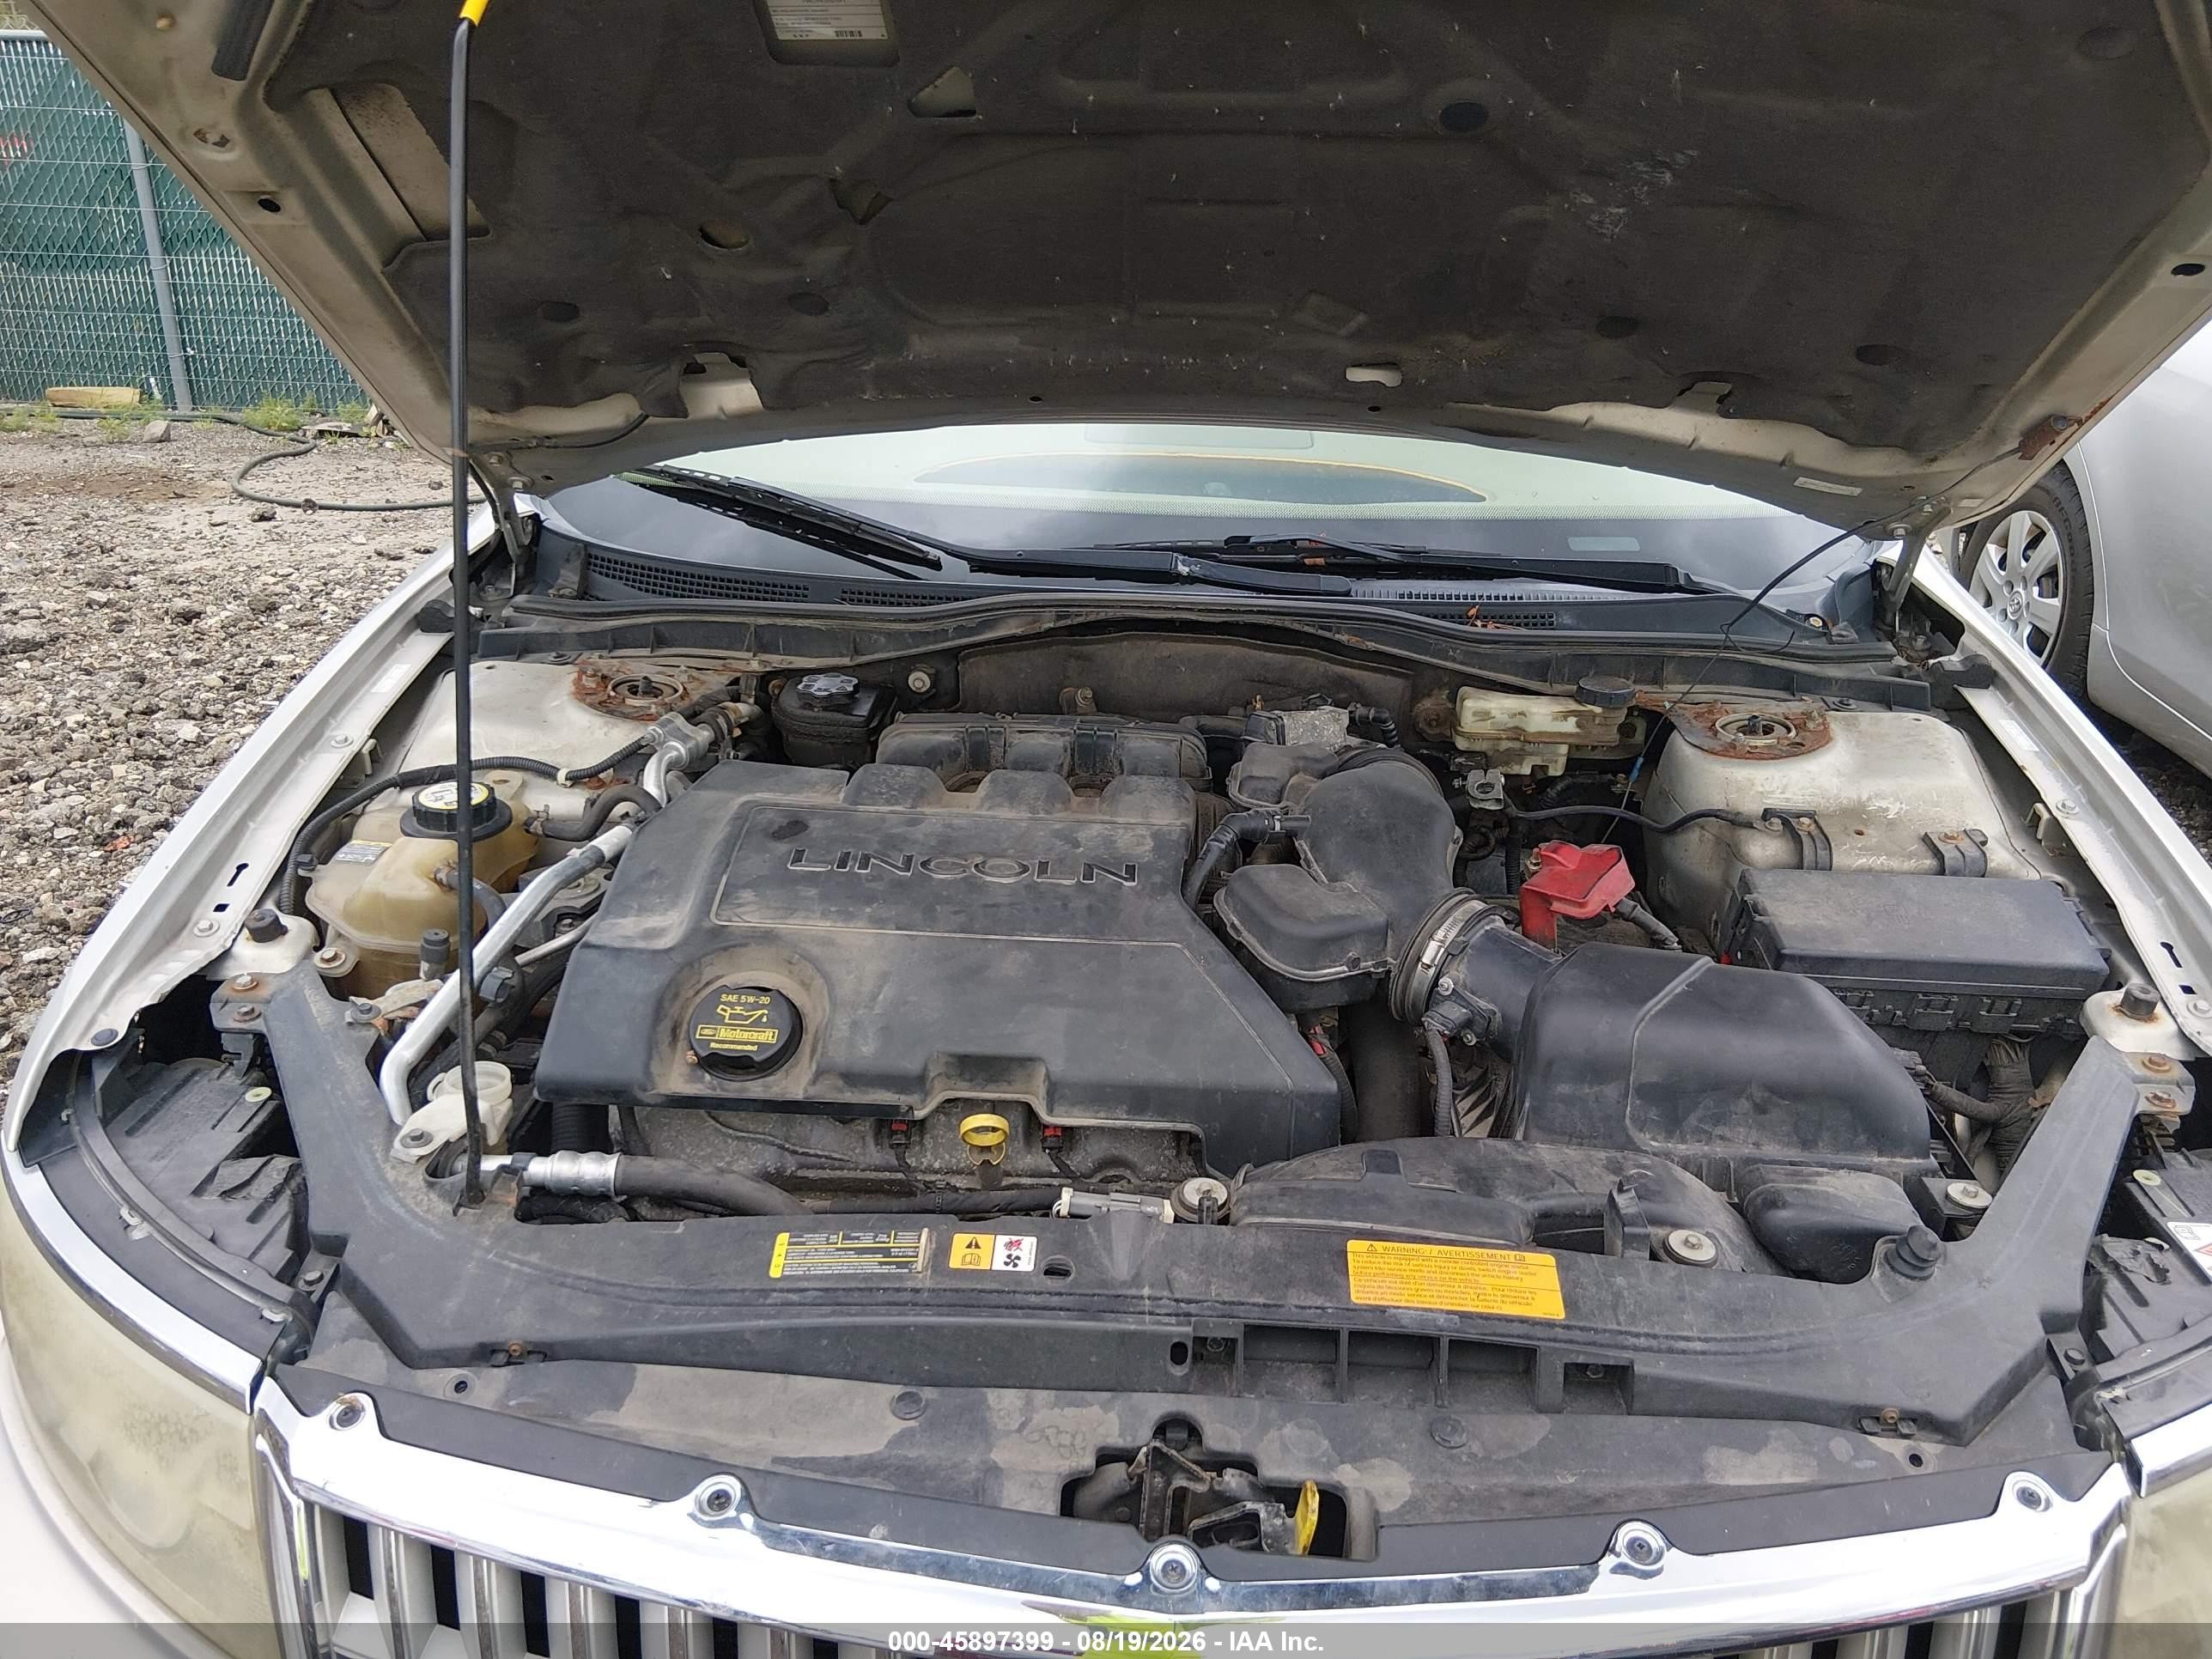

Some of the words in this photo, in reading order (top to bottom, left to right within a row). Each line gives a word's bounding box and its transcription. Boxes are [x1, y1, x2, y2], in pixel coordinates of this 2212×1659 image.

[787, 847, 1138, 885] LINCOLN
[720, 994, 738, 1003] SAE
[739, 994, 771, 1005] 5W-20
[719, 1028, 775, 1041] Motorcraft
[709, 1042, 758, 1051] Recommended
[1437, 1249, 1511, 1261] AVERTISSEMENT
